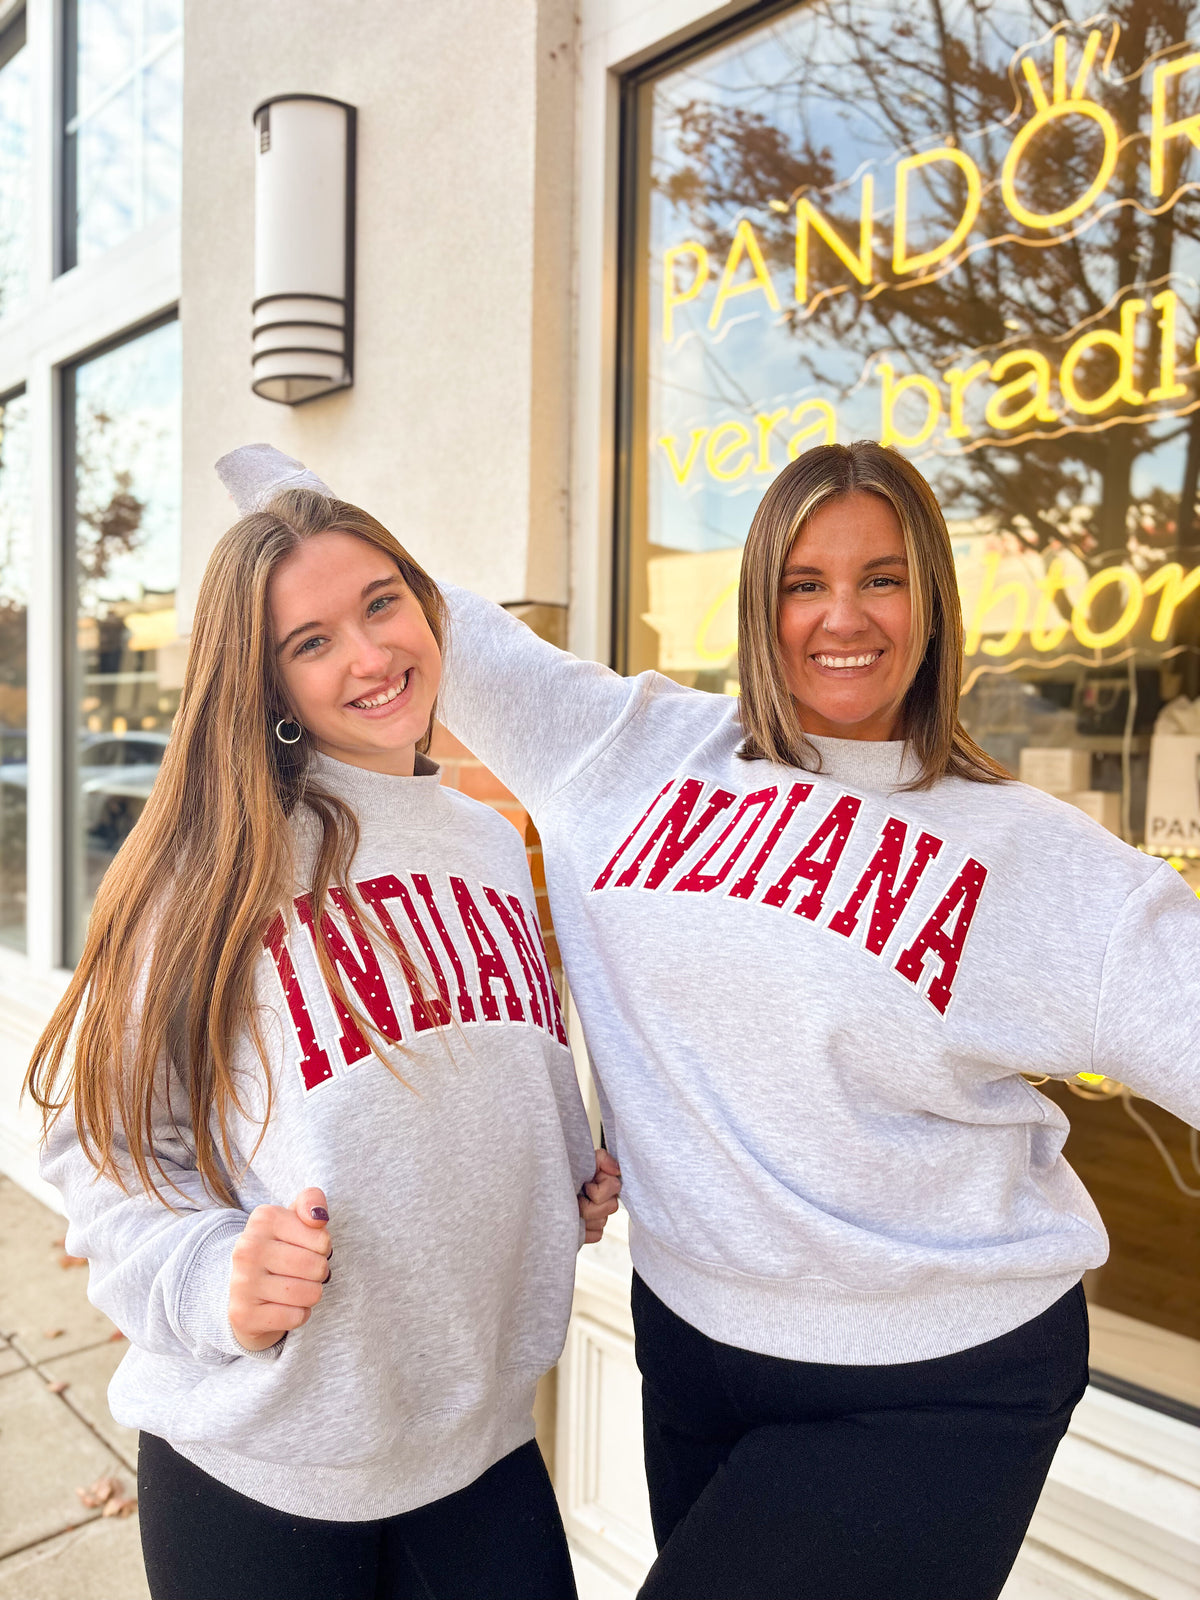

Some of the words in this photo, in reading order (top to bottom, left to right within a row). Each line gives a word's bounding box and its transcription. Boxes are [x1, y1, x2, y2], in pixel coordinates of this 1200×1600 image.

[662, 30, 1200, 343] PANDOR
[658, 398, 836, 486] vera
[875, 290, 1200, 448] bradl
[587, 776, 990, 1021] INDIANA
